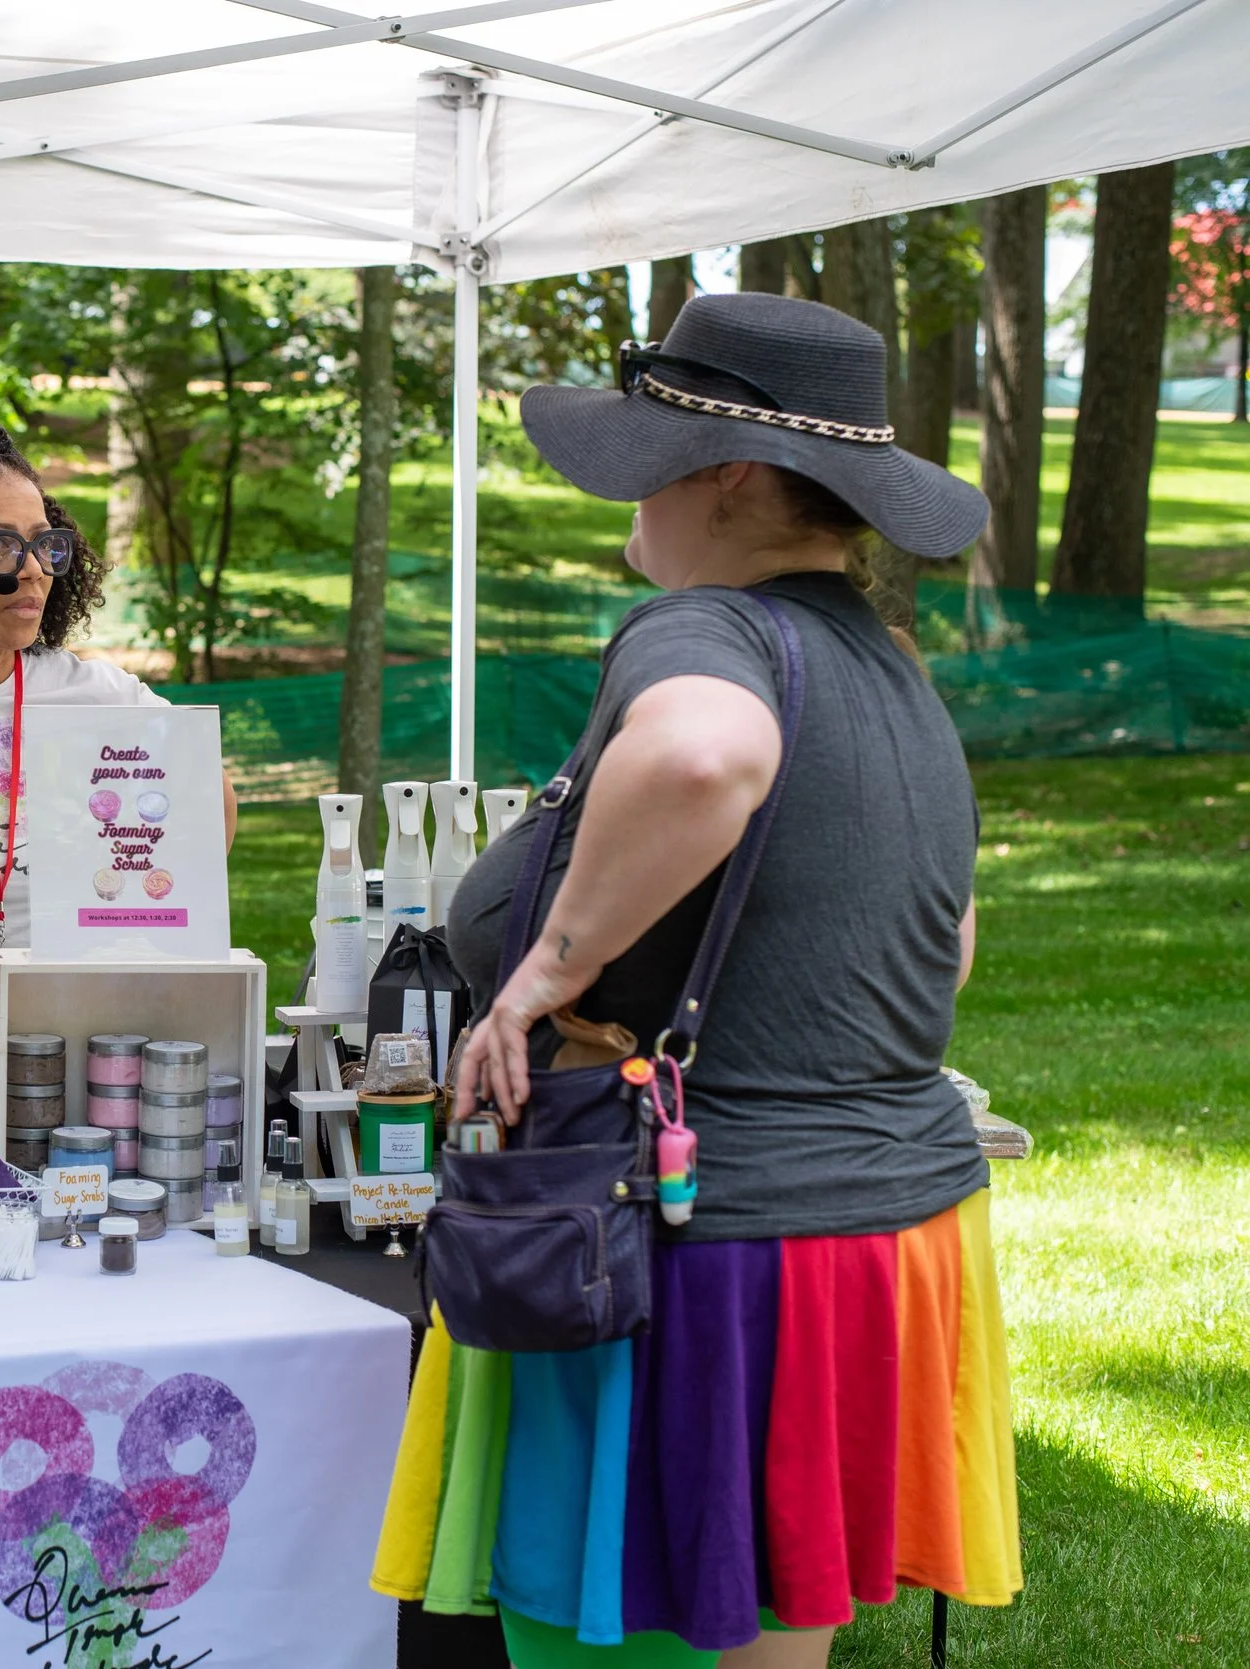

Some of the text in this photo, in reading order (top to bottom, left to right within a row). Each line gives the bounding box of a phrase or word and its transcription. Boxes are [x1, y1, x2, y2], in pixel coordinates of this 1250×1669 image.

[100, 745, 150, 762] Create
[90, 767, 166, 785] your own
[98, 822, 164, 844] Foaming
[110, 840, 154, 859] Sugar
[112, 857, 154, 871] Scrub
[59, 1171, 101, 1188] Foaming
[54, 1189, 105, 1209] Sugar Scrubs
[352, 1183, 384, 1200] Project
[375, 1199, 409, 1209] Candle
